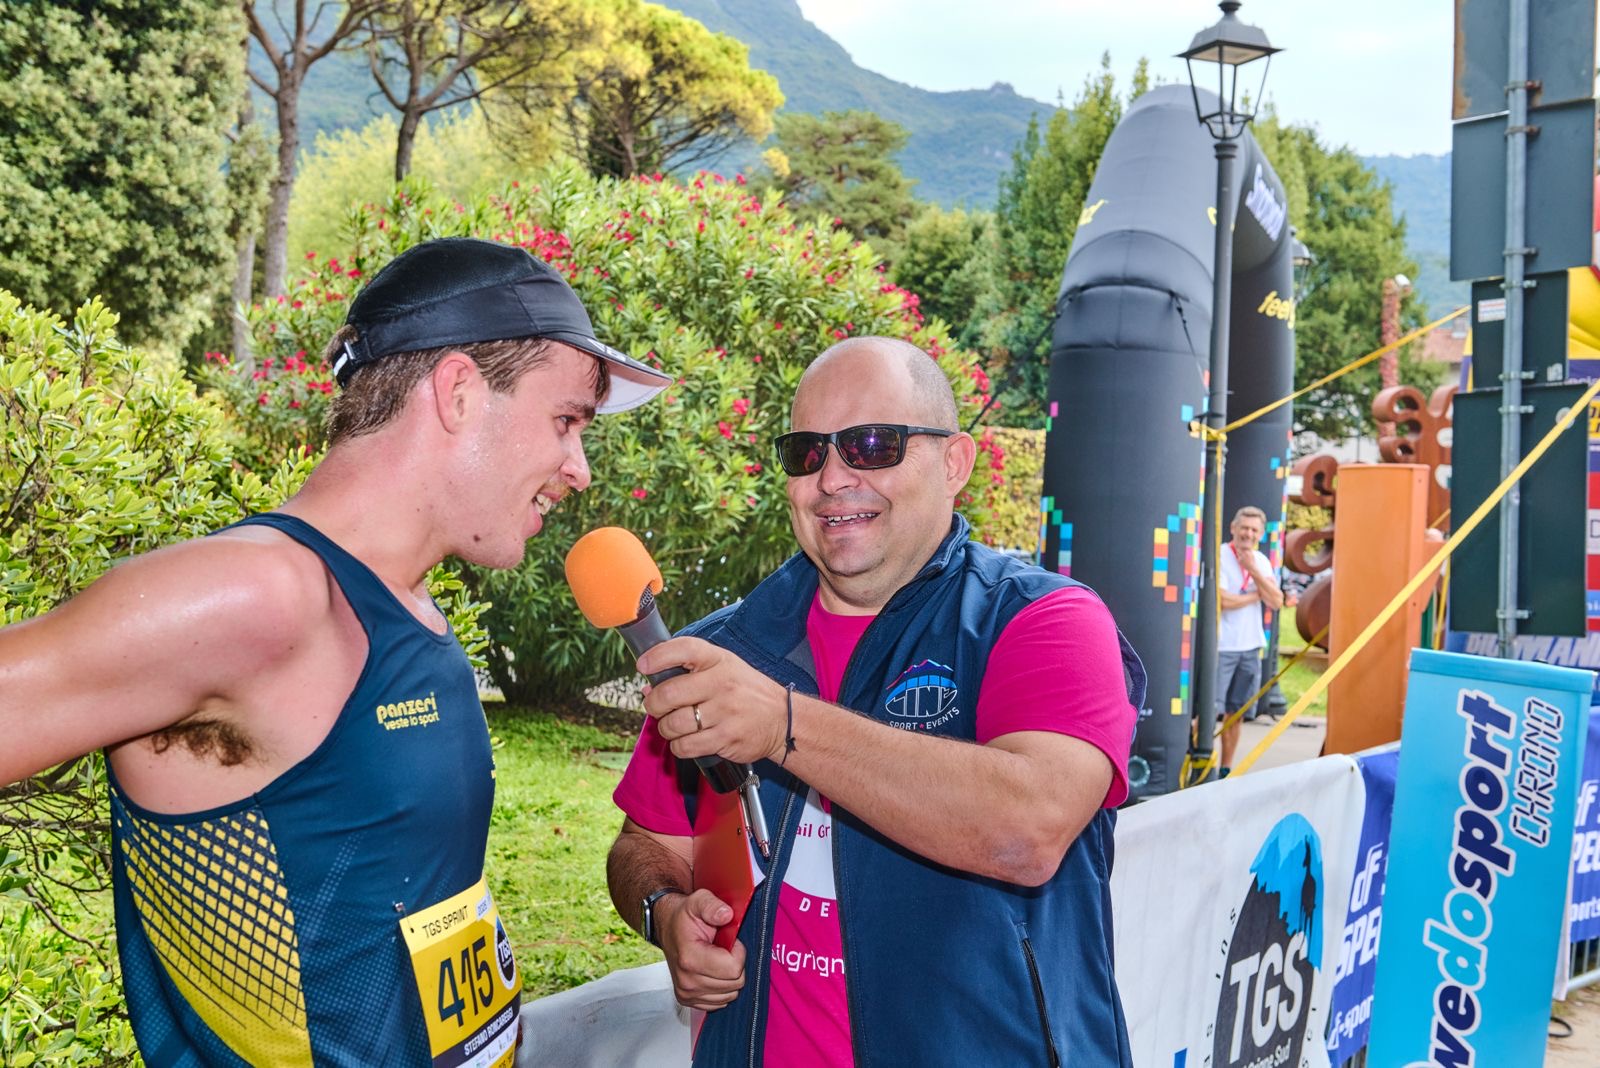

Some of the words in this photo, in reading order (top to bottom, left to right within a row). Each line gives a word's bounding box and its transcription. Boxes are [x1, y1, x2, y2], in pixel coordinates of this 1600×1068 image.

[376, 691, 437, 724] panzeri
[384, 715, 409, 730] veste
[418, 711, 440, 728] sport
[889, 721, 918, 730] SPORT
[926, 706, 960, 730] EVENTS
[1510, 697, 1563, 848] CHRONO
[421, 919, 443, 939] TGS
[443, 904, 469, 930] SPRINT
[438, 935, 494, 1028] 415
[1229, 930, 1308, 1064] TGS
[464, 1028, 488, 1056] STEFANO
[1274, 1037, 1292, 1067] Sud
